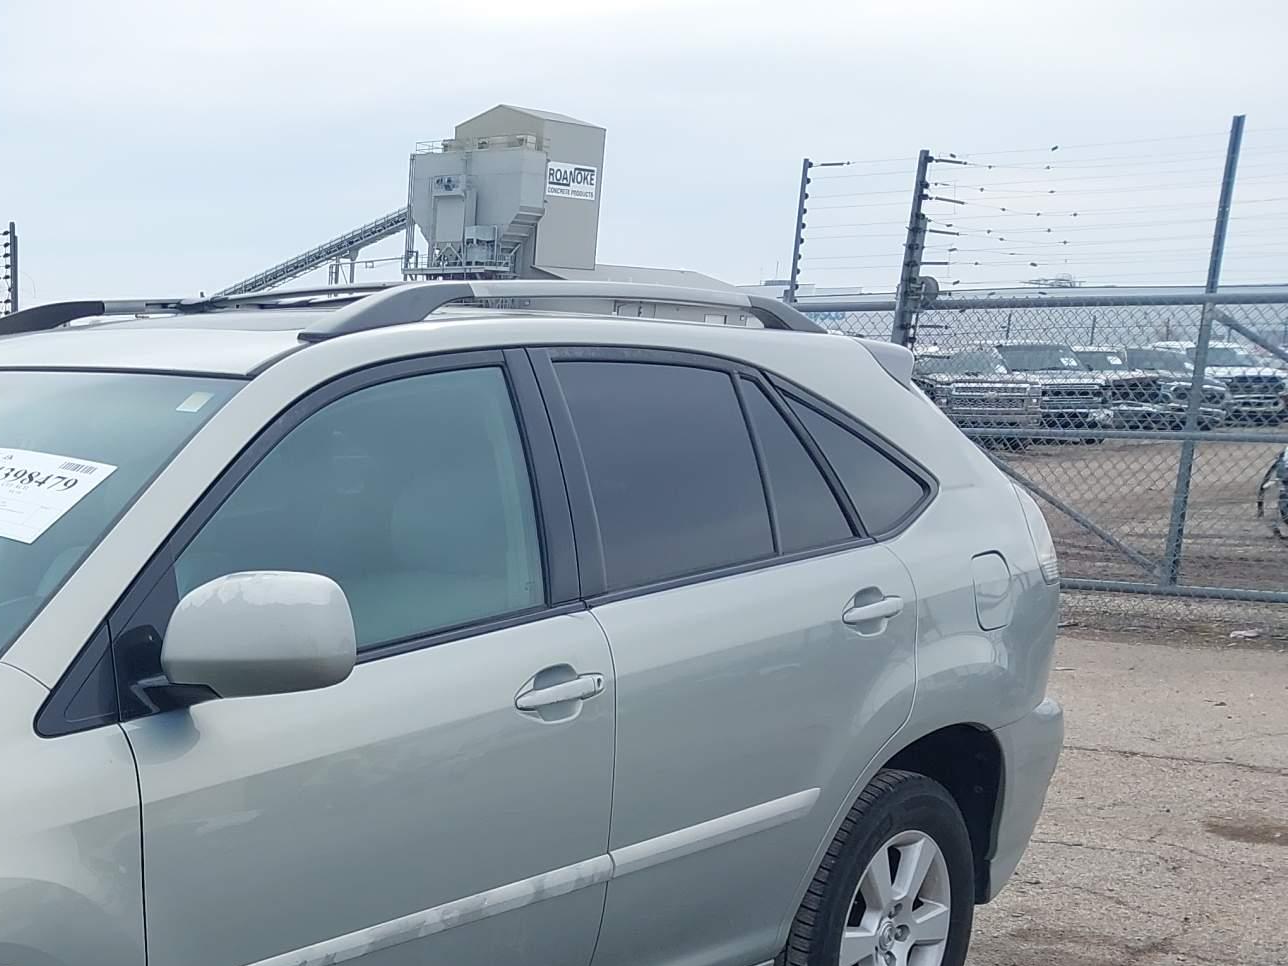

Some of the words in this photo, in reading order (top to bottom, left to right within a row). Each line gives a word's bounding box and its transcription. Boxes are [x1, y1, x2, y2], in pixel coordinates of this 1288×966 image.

[548, 167, 595, 186] ROANOKE
[547, 187, 570, 195] CONCRETE
[571, 189, 594, 198] PRODUCTS
